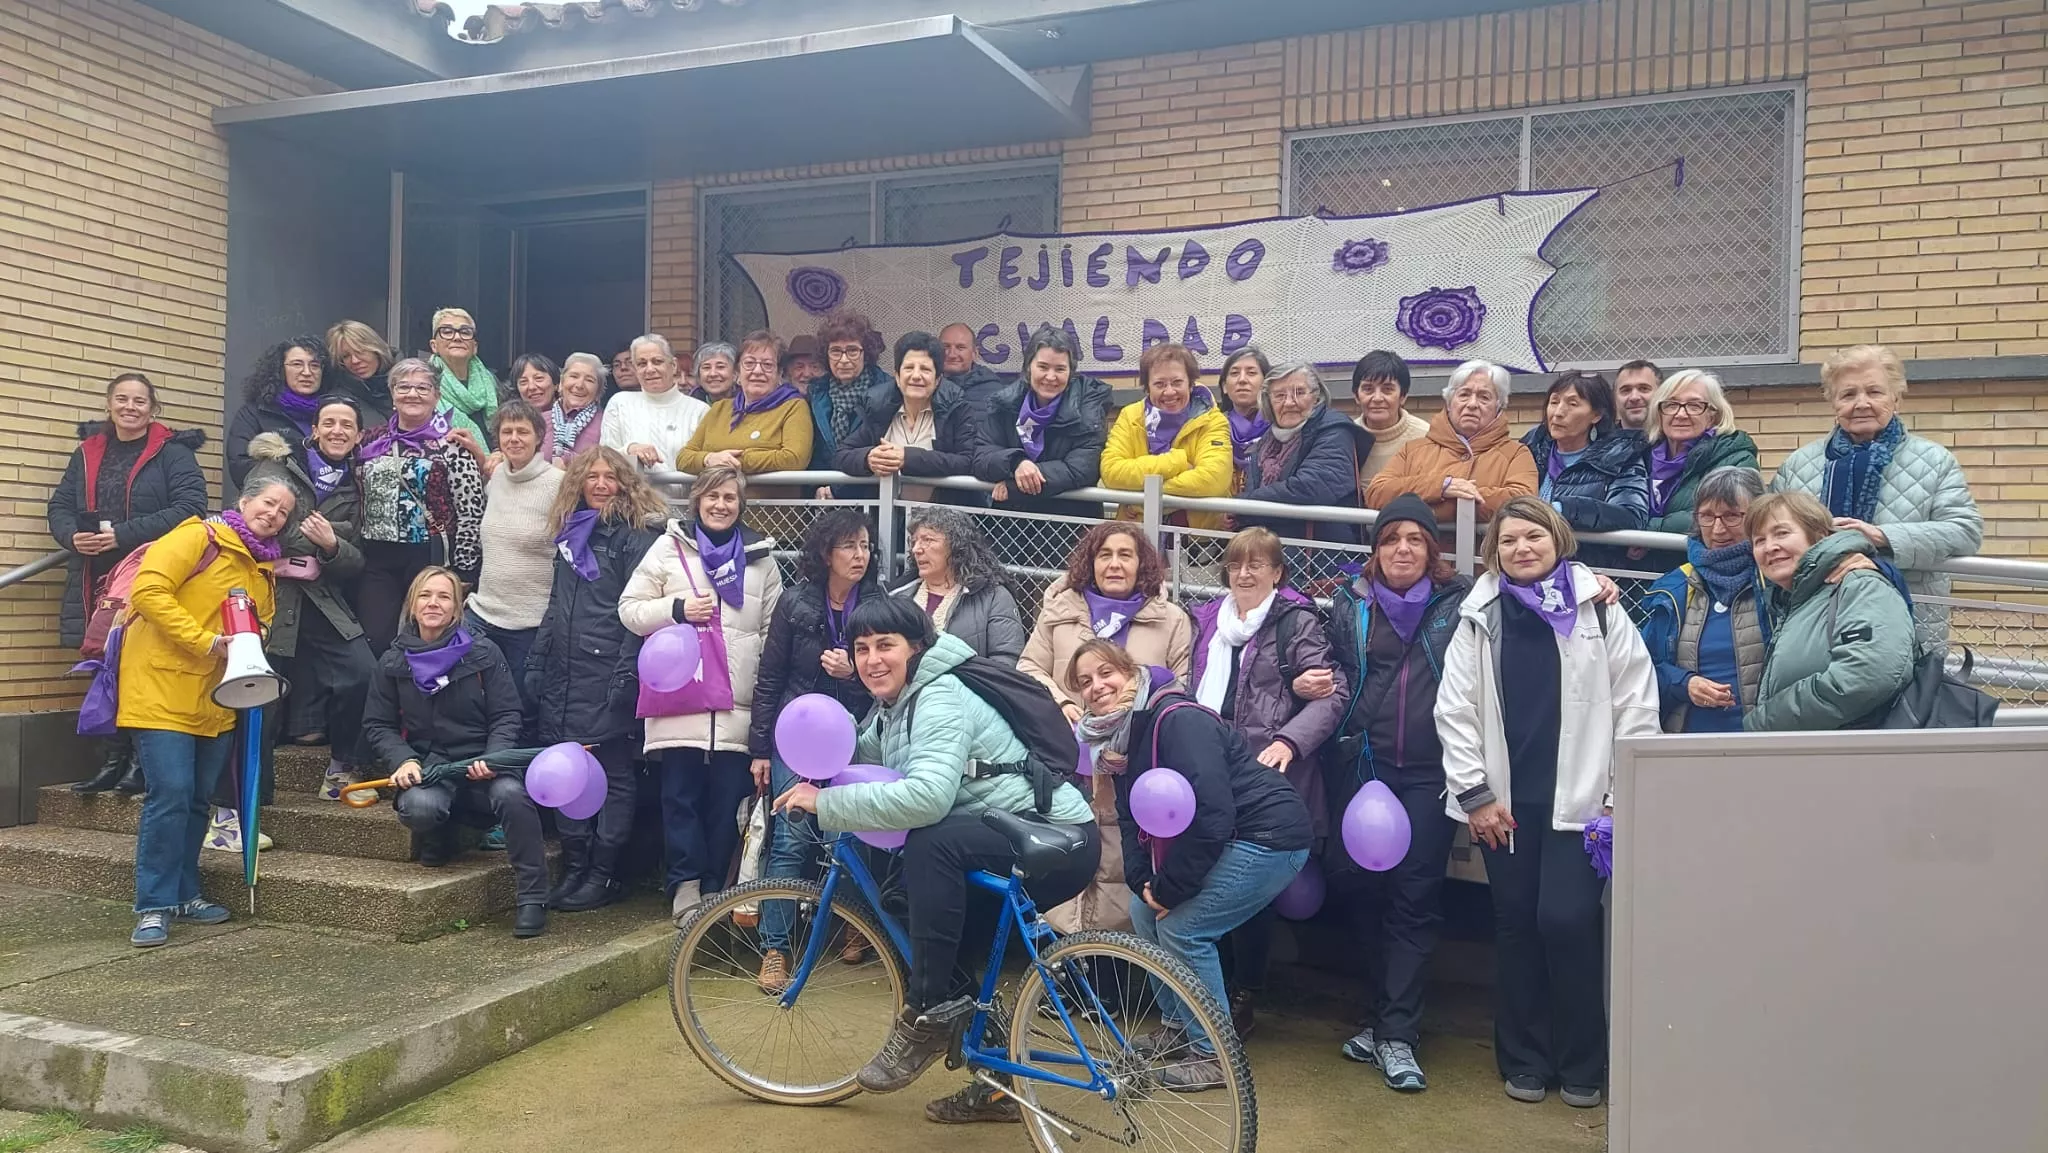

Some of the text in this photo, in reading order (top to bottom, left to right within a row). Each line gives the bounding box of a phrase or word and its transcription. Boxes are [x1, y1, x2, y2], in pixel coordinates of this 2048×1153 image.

[952, 238, 1266, 291] TEJIENDO
[320, 465, 333, 476] 8M
[1093, 618, 1107, 633] 8M
